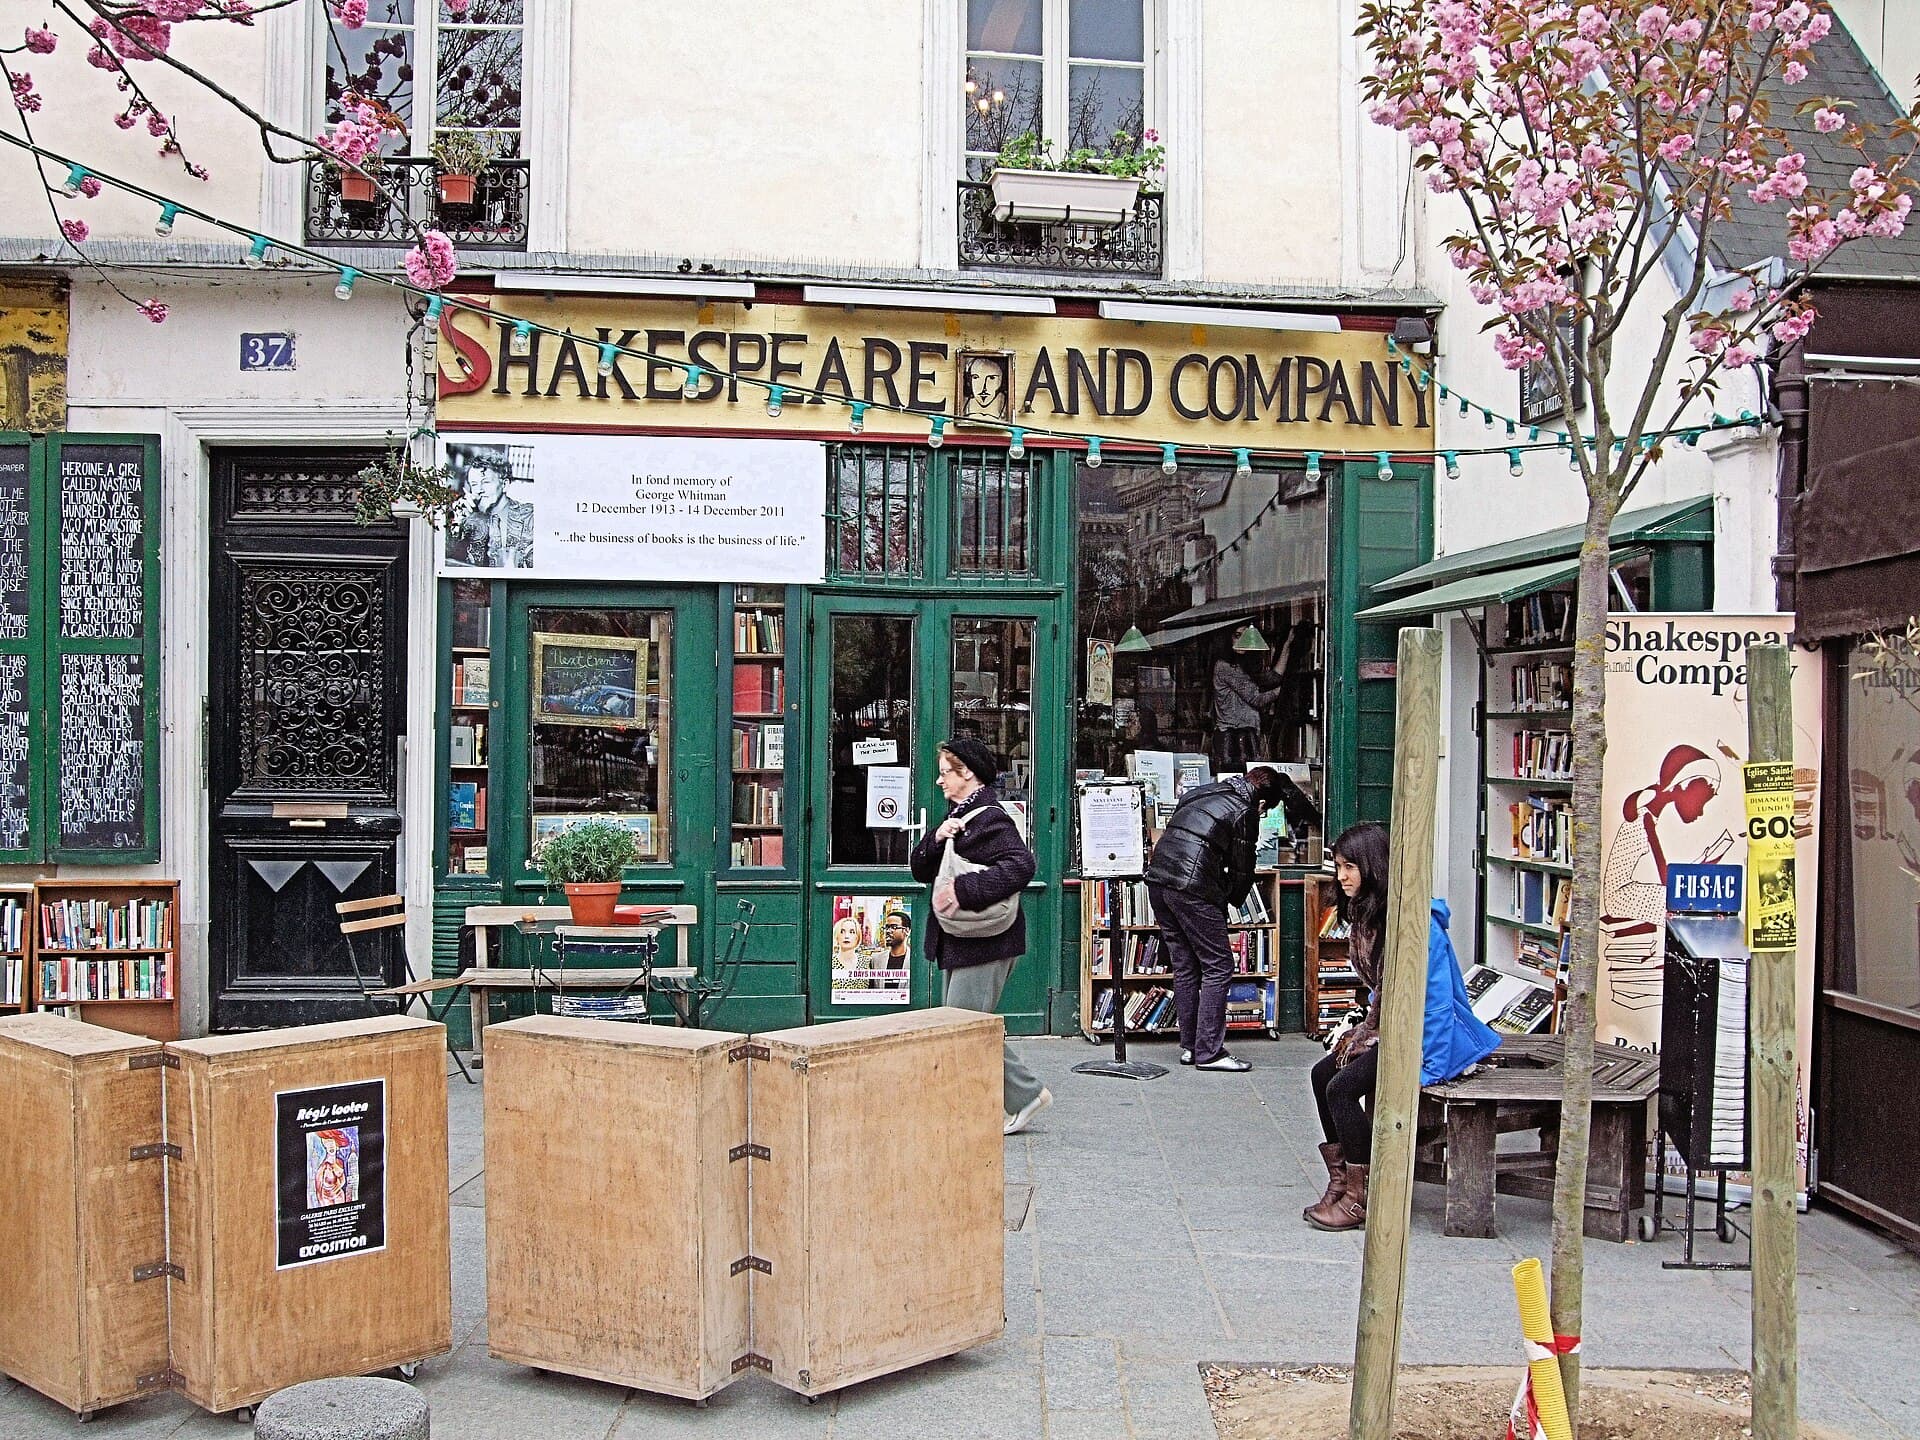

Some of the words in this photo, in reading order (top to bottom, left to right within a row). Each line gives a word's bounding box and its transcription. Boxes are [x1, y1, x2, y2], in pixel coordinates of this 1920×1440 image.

[248, 338, 287, 366] 37
[437, 295, 948, 411] SHAKESPEARE
[1024, 345, 1154, 417] AND
[1169, 352, 1431, 429] COMPANY
[107, 463, 114, 476] A
[119, 463, 141, 476] GIRL
[63, 477, 97, 490] CALLED
[100, 477, 141, 491] NASTASIA
[631, 473, 642, 485] In
[647, 474, 670, 486] fond
[673, 476, 717, 489] memory
[719, 475, 733, 487] of
[12, 488, 24, 499] ME
[113, 492, 133, 504] ONE
[635, 488, 675, 503] George
[678, 489, 726, 501] Whitman
[62, 504, 105, 518] HUNDRED
[109, 505, 139, 518] YEARS
[576, 502, 588, 513] 12
[591, 502, 647, 514] December
[651, 503, 676, 515] 1913
[688, 504, 700, 515] 14
[703, 504, 758, 516] December
[760, 505, 784, 517] 2011
[84, 519, 98, 532] MY
[100, 519, 143, 533] BOOKSTORE
[61, 533, 79, 545] WAS
[80, 533, 86, 545] A
[88, 533, 109, 545] WINE
[111, 533, 136, 548] SHOP
[589, 531, 634, 544] business
[637, 532, 650, 544] of
[652, 532, 684, 544] books
[687, 533, 696, 545] is
[698, 533, 715, 545] the
[718, 534, 763, 546] business
[765, 535, 779, 546] of
[3, 539, 24, 552] THE
[62, 546, 90, 559] HIDDEN
[92, 546, 113, 559] FROM
[116, 546, 133, 559] THE
[1, 553, 21, 566] CAN
[62, 559, 87, 572] SEINE
[89, 560, 100, 572] BY
[101, 560, 113, 572] AN
[116, 560, 142, 573] ANNEX
[62, 572, 71, 584] OF
[74, 572, 89, 584] THE
[91, 572, 115, 584] HOTEL
[61, 585, 95, 598] HOSPITAL
[96, 585, 121, 597] WHICH
[125, 586, 142, 597] HAS
[61, 597, 82, 610] SINCE
[84, 598, 103, 610] BEEN
[91, 610, 131, 624] REPLACED
[133, 610, 142, 624] BY
[61, 624, 68, 636] A
[112, 624, 134, 637] AND
[1605, 621, 1820, 662] Shakespear
[9, 655, 26, 667] HAS
[62, 654, 103, 665] FURTHER
[105, 655, 127, 664] BACK
[131, 655, 138, 664] IN
[64, 664, 80, 673] THE
[82, 664, 104, 674] YEAR
[108, 664, 127, 673] 1600
[1636, 655, 1798, 696] Compa
[62, 674, 78, 685] OUR
[80, 673, 105, 685] WHOLE
[2, 690, 21, 702] AND
[61, 685, 78, 695] WAS
[80, 685, 87, 695] A
[90, 685, 138, 695] MONASTERY
[62, 695, 93, 705] CALLED
[96, 695, 106, 705] LA
[62, 705, 74, 716] DU
[119, 705, 128, 716] IN
[62, 716, 103, 728] MEDIEVAL
[106, 716, 132, 728] TIMES
[62, 728, 80, 740] EACH
[62, 799, 90, 810] YEARS
[128, 799, 135, 811] IS
[62, 810, 75, 822] MY
[299, 1235, 366, 1257] EXPOSITION
